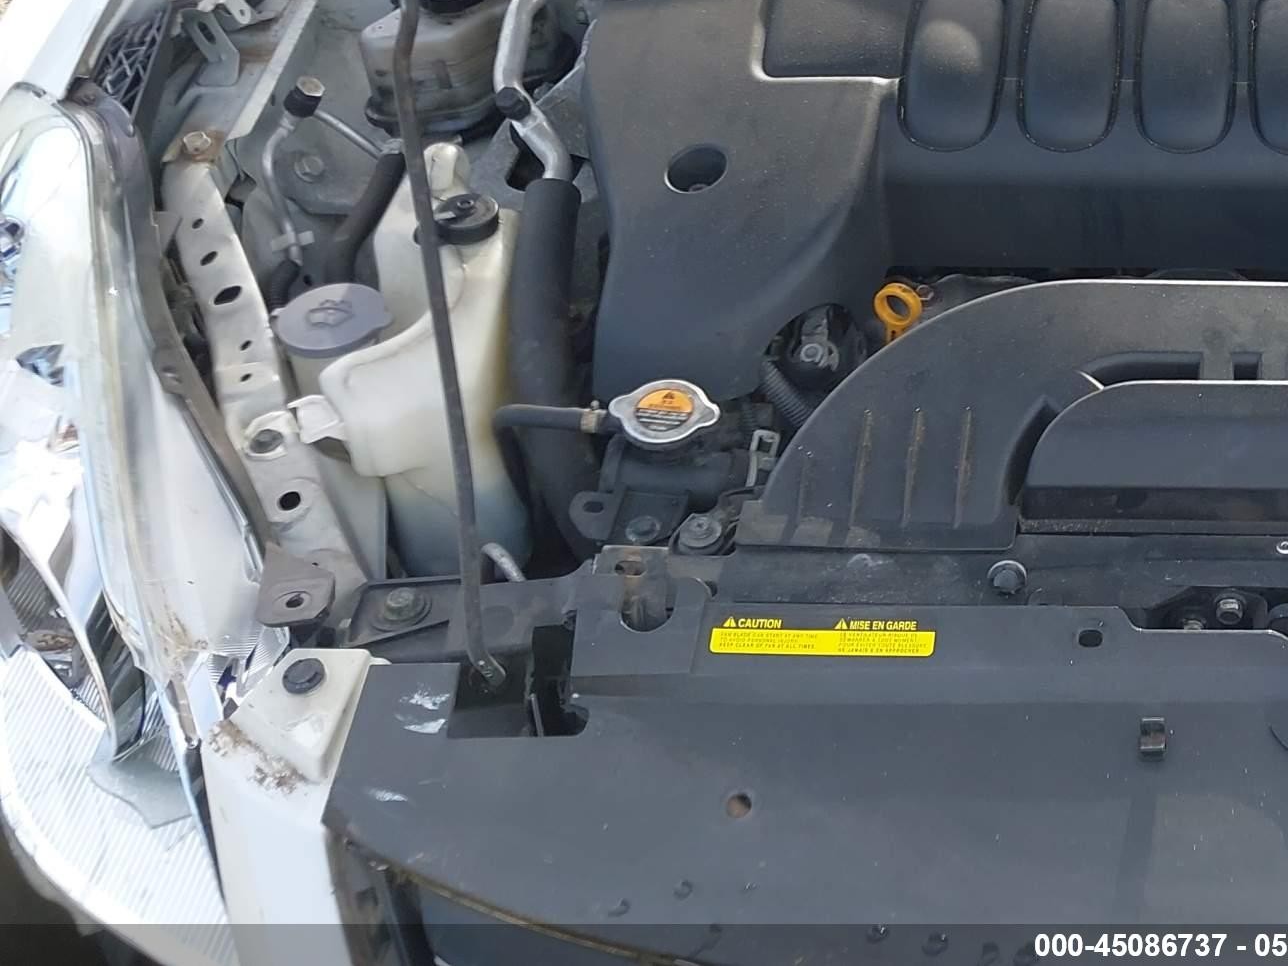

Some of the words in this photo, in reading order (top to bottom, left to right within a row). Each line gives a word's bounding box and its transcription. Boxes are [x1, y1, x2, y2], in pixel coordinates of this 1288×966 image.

[738, 618, 782, 629] CAUTION
[849, 620, 871, 631] MISE
[872, 620, 885, 631] EN
[886, 620, 918, 631] GARDE
